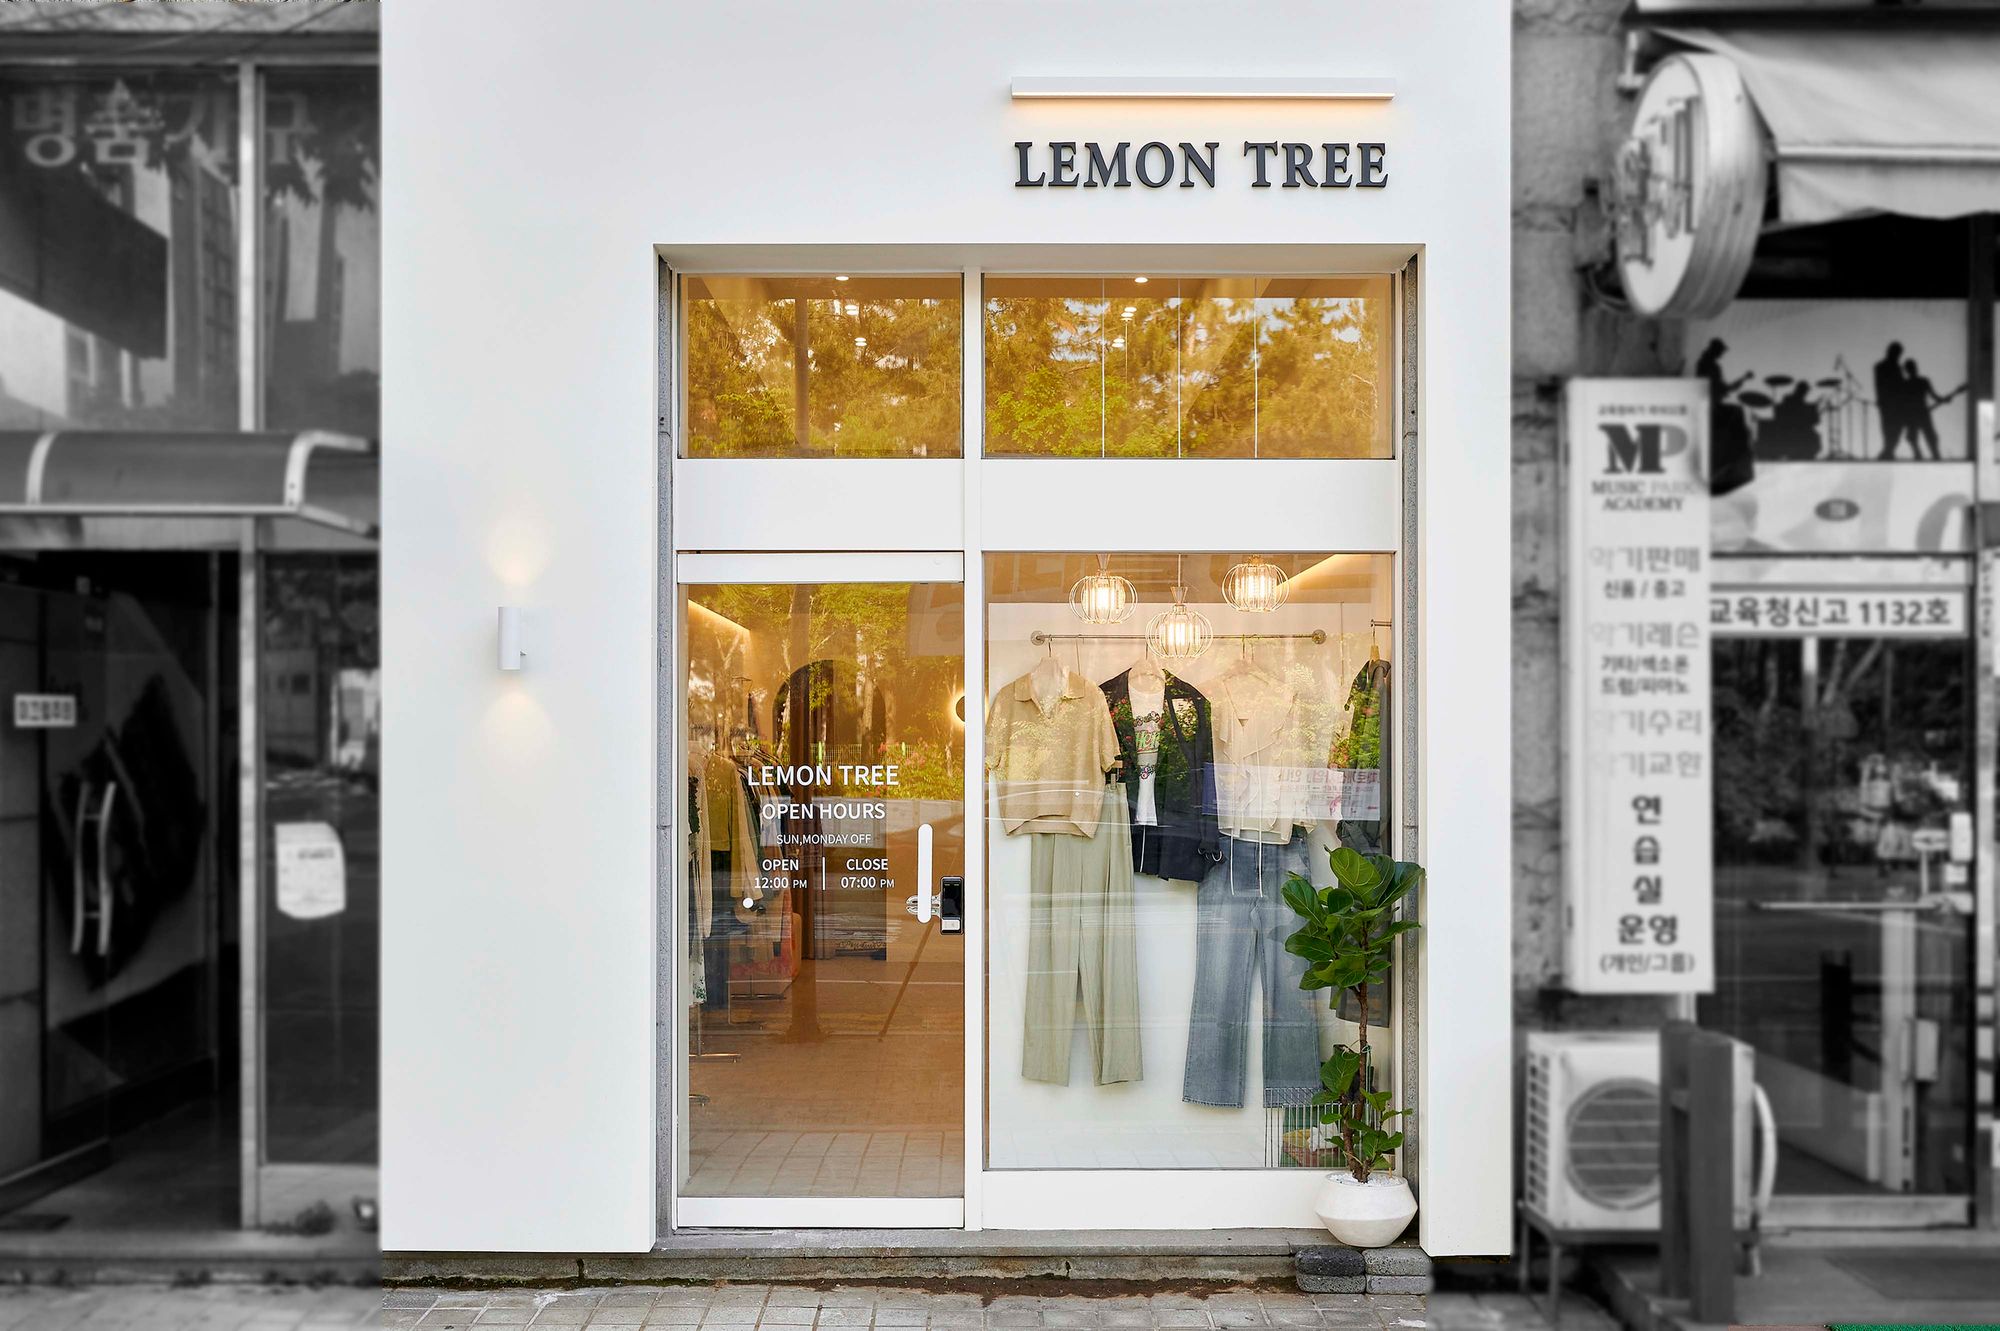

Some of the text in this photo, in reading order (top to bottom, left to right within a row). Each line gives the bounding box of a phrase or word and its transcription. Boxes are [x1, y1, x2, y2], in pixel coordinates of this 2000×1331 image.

[1014, 140, 1389, 189] LEMON TREE
[1597, 423, 1689, 475] MP
[1592, 481, 1645, 495] MUSIC
[1602, 497, 1685, 511] ACADEMY
[1710, 598, 1951, 627] 교육청신고 1132호
[747, 765, 899, 786] LEMON TREE
[762, 803, 886, 820] OPEN HOURS
[776, 834, 872, 847] SUN,MONDAY OFF
[762, 859, 889, 871] OPEN CLOSE
[754, 877, 895, 889] 12:00 PM 07:00 PM
[1618, 914, 1678, 945] 운영
[1600, 953, 1696, 974] (개인/그룹)
